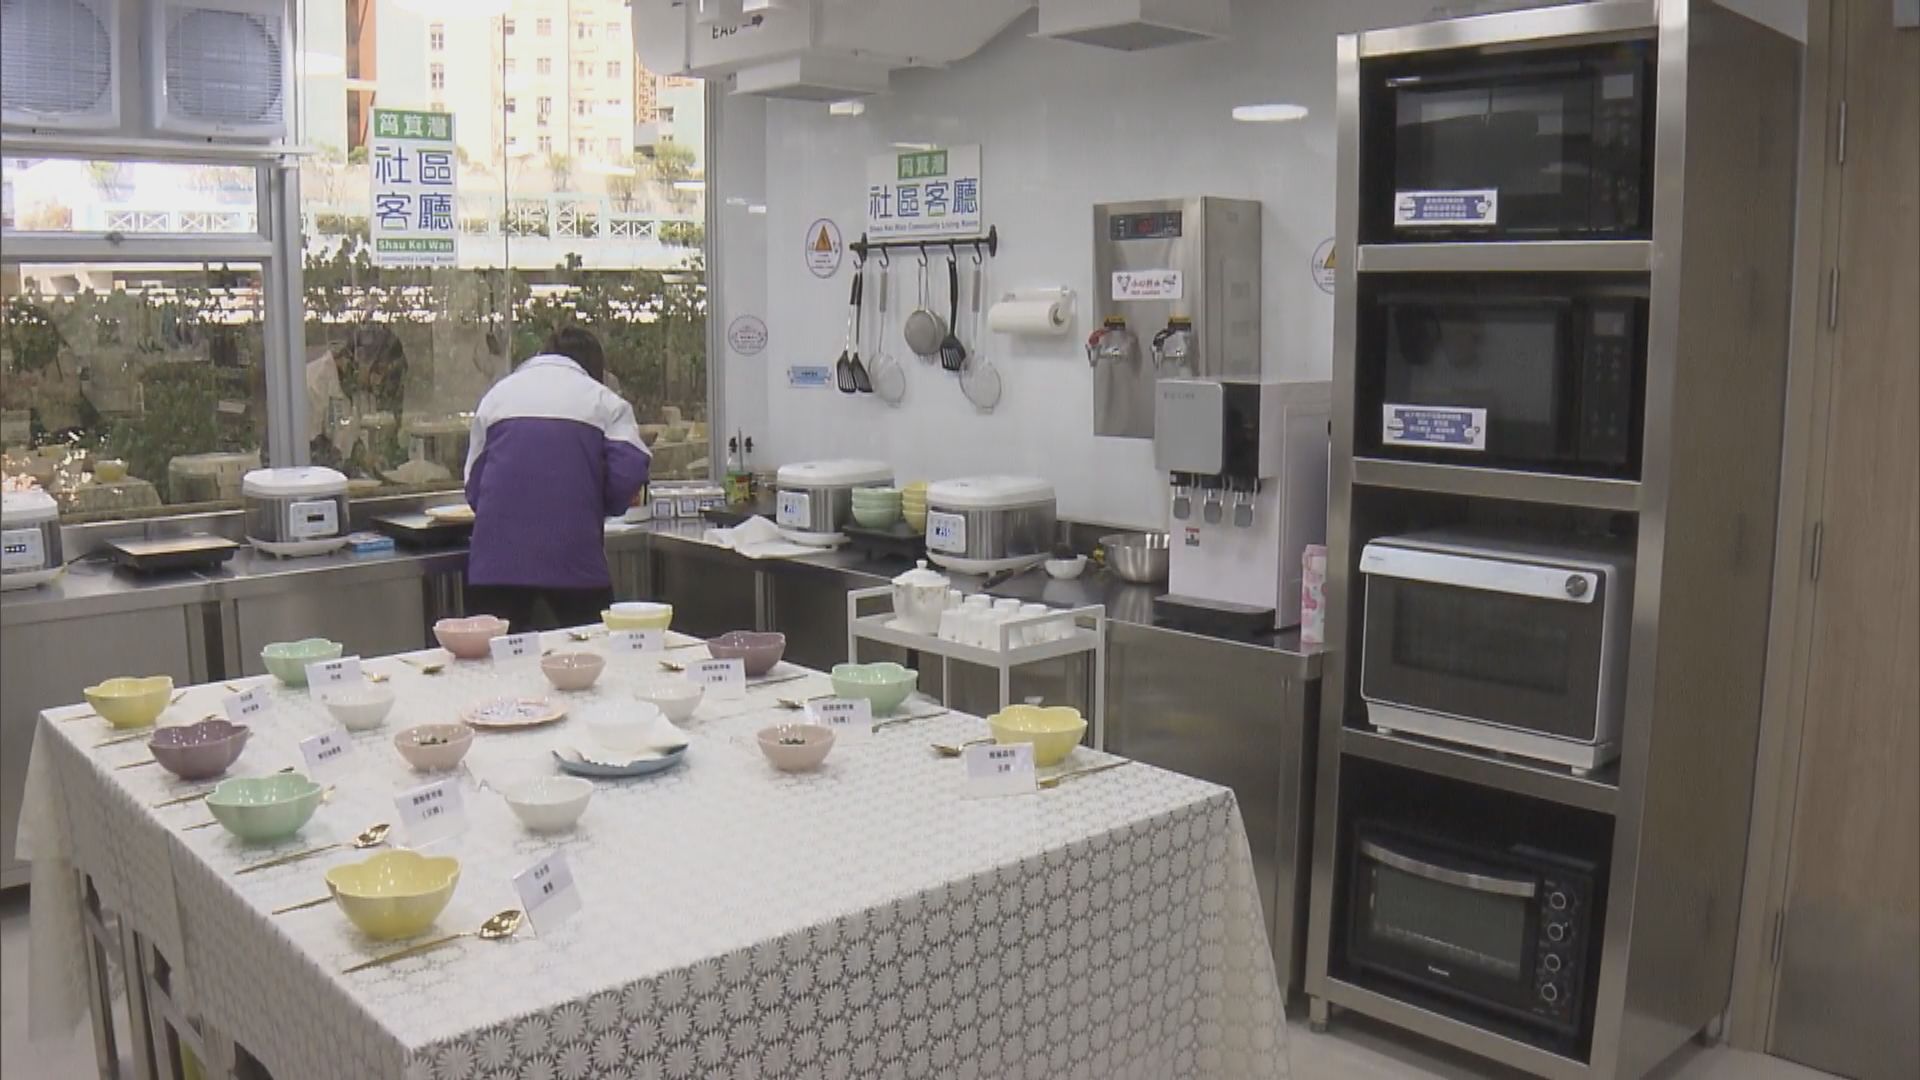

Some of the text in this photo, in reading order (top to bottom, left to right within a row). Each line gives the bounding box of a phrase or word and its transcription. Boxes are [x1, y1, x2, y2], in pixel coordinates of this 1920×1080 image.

[375, 147, 453, 184] 社區
[375, 192, 453, 231] 客廳
[869, 177, 978, 220] 社區客廳
[378, 240, 452, 250] Shau Kei Wan
